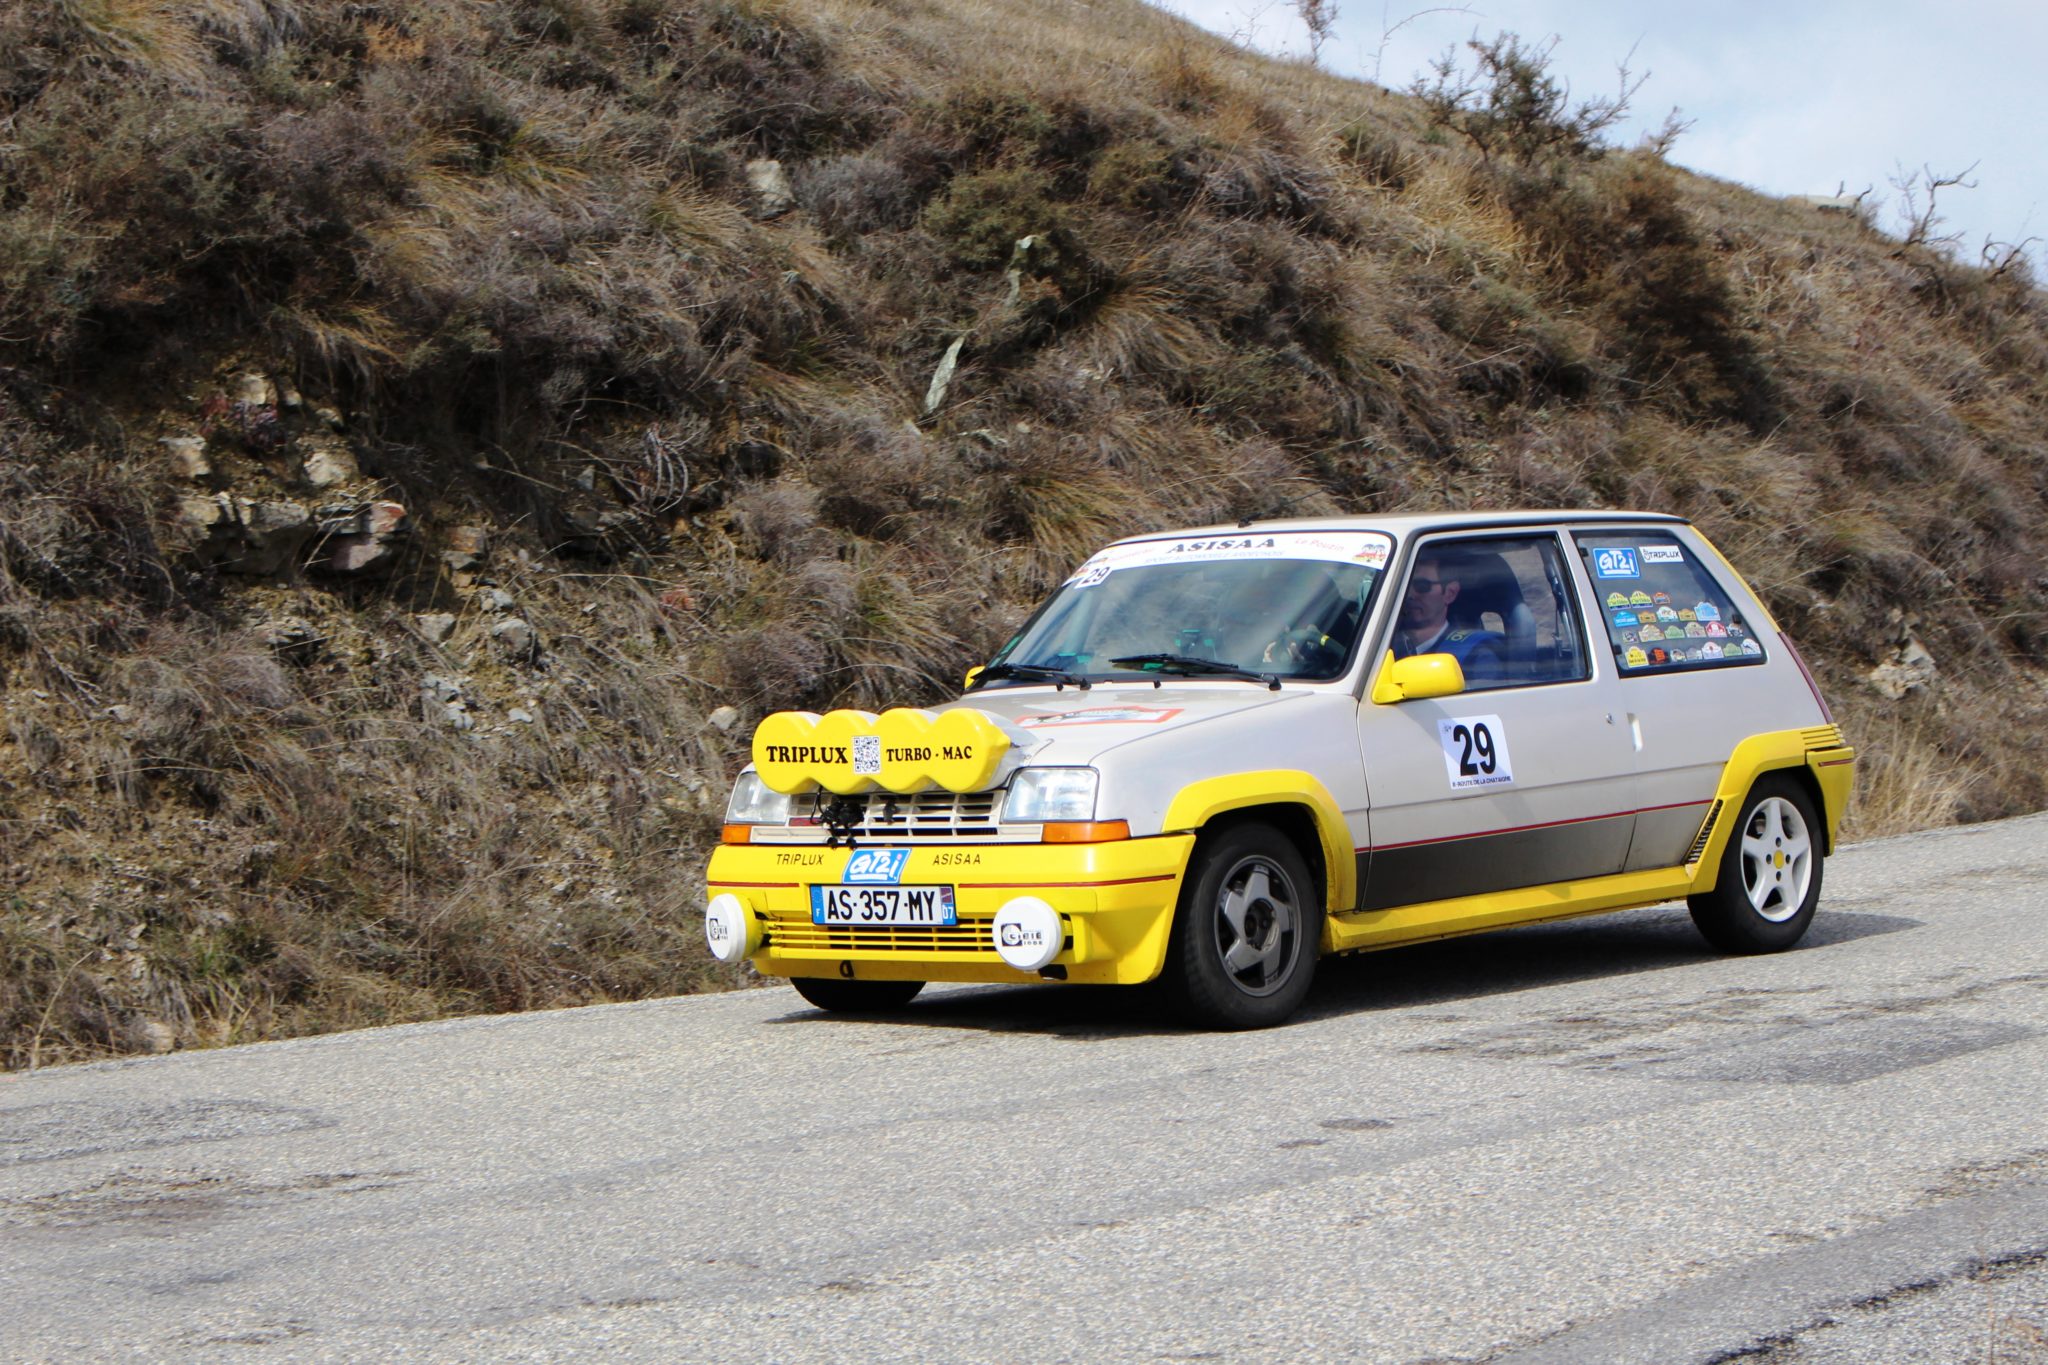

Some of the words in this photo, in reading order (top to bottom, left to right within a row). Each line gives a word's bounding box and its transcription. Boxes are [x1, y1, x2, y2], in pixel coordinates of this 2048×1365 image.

[1166, 538, 1275, 553] ASISAA
[1649, 551, 1681, 559] TRIPLUX
[1081, 566, 1111, 585] 29
[766, 745, 848, 764] TRIPLUX
[886, 747, 931, 762] TURBO
[942, 746, 972, 760] MAC
[1453, 722, 1497, 777] 29
[776, 853, 824, 865] TRIPLUX
[932, 853, 981, 865] ASISAA
[815, 908, 820, 917] F
[942, 906, 954, 919] 07
